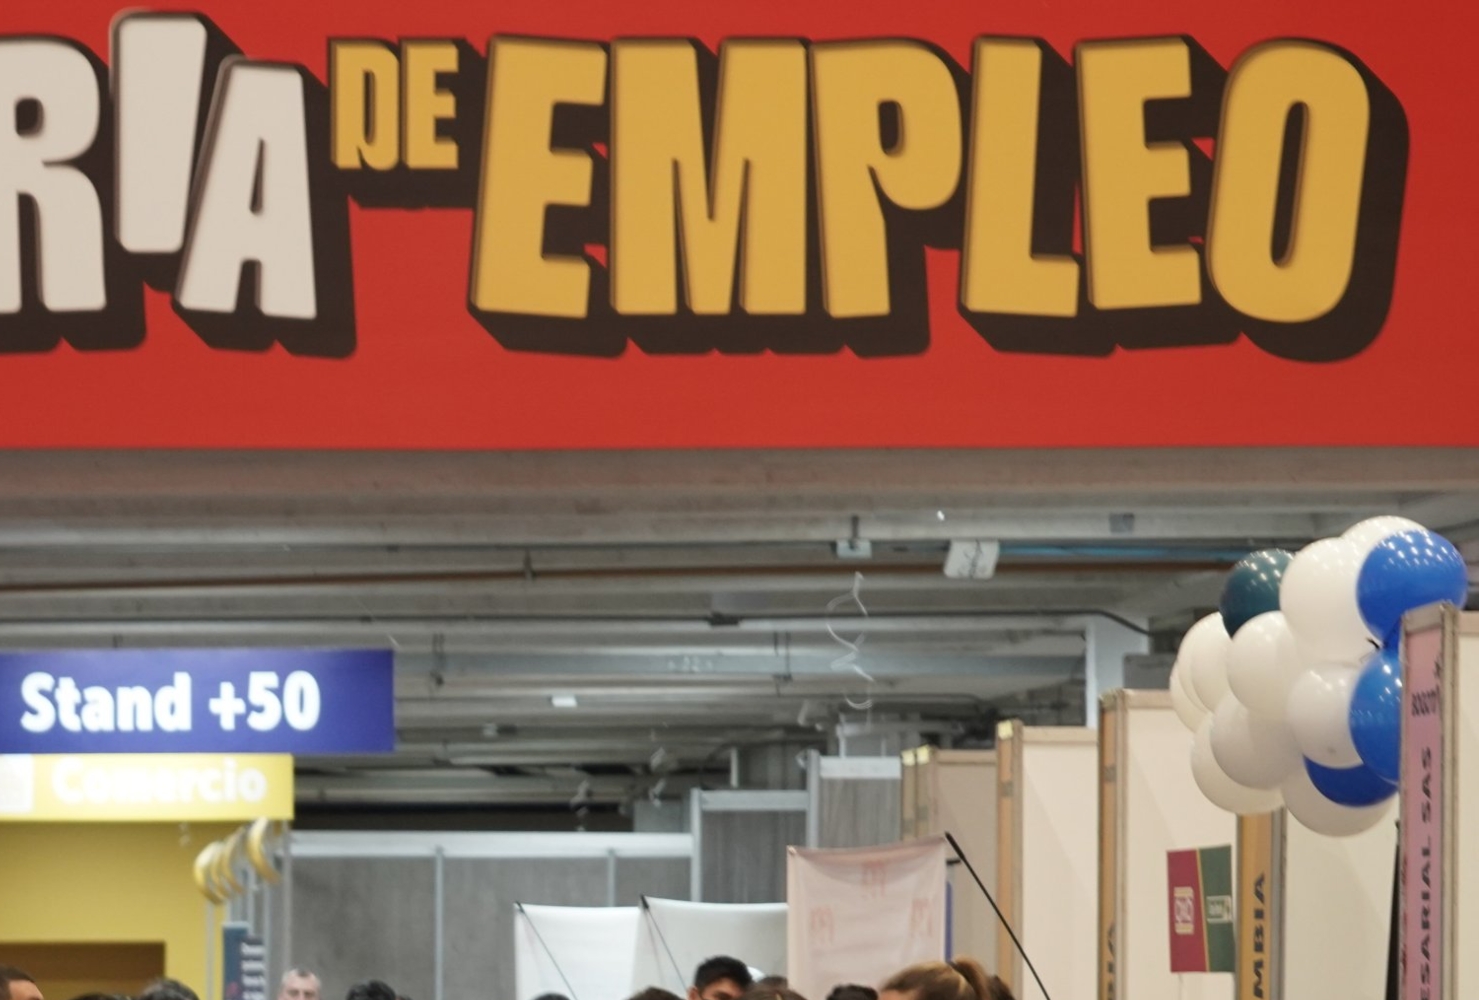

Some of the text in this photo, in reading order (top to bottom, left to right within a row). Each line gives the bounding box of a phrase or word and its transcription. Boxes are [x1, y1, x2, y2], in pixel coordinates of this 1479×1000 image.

[328, 38, 459, 172] DE
[470, 36, 1372, 324] EMPLEO
[20, 670, 321, 733] Stand +50
[51, 756, 268, 804] Comercio
[1421, 746, 1432, 824] SAS
